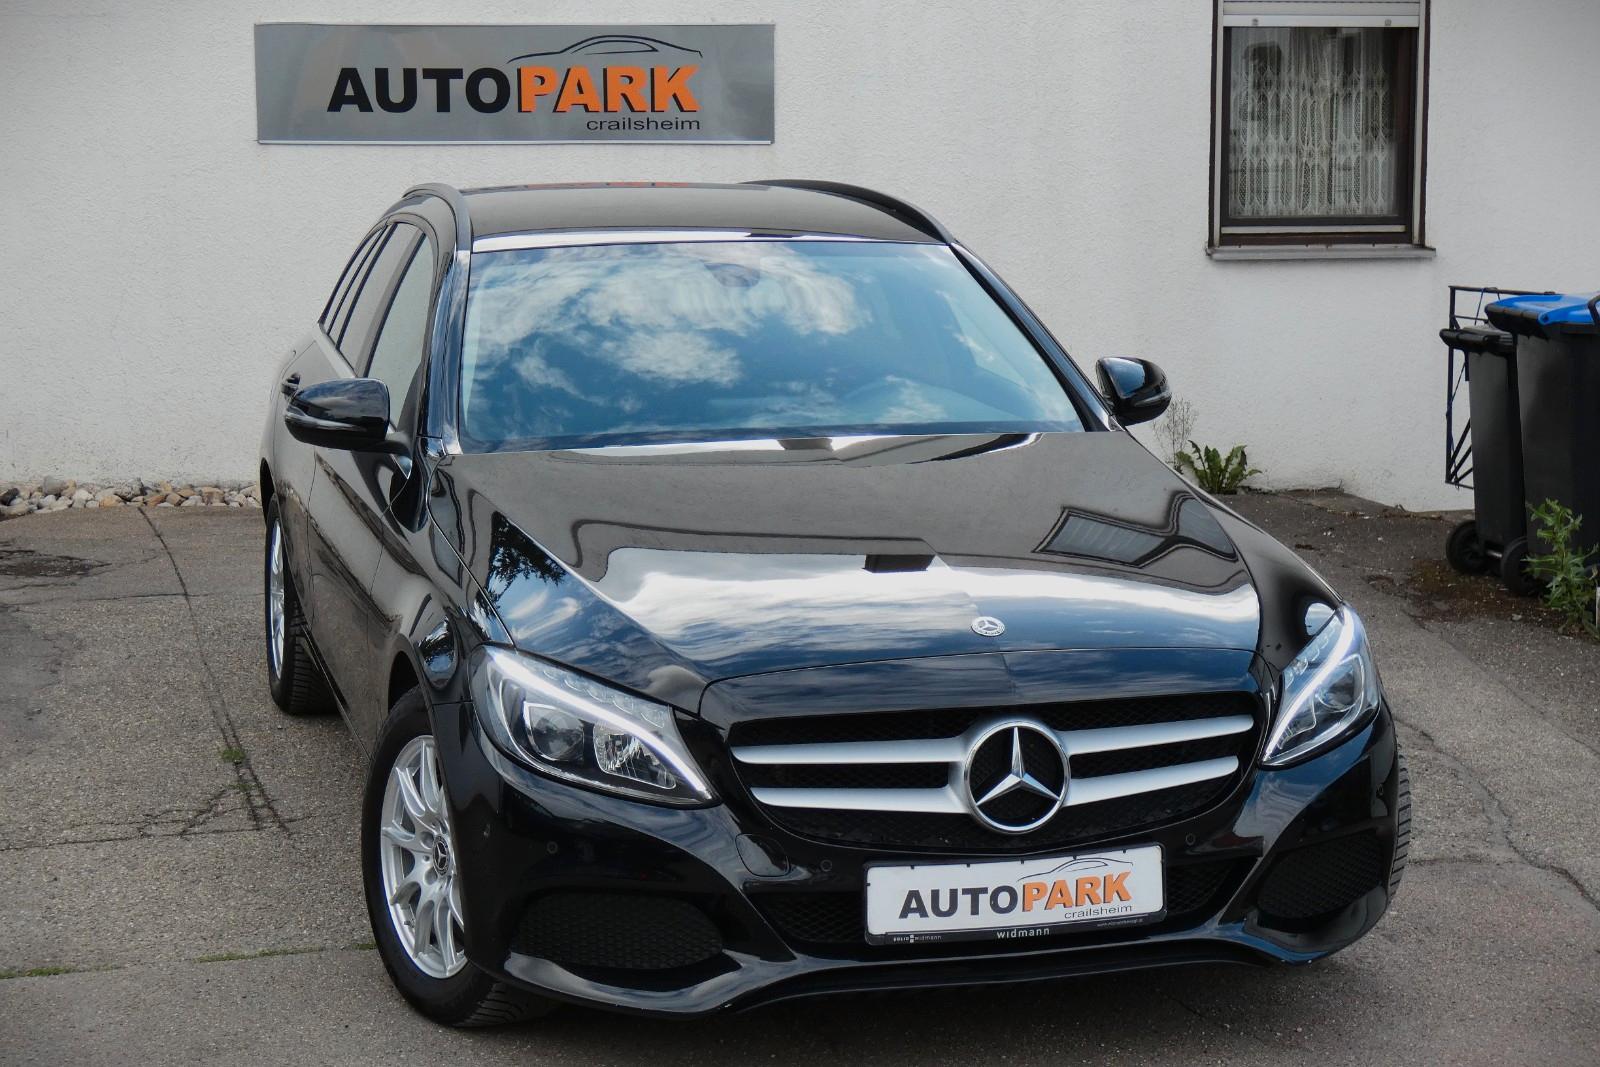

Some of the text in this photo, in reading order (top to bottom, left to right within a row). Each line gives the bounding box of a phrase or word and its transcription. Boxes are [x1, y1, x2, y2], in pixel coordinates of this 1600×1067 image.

[326, 66, 701, 114] AUTOPARK
[586, 116, 701, 131] crailsheim
[898, 871, 1132, 919] AUTOPARK
[1063, 904, 1133, 920] crailsheim
[996, 927, 1051, 940] widmann
